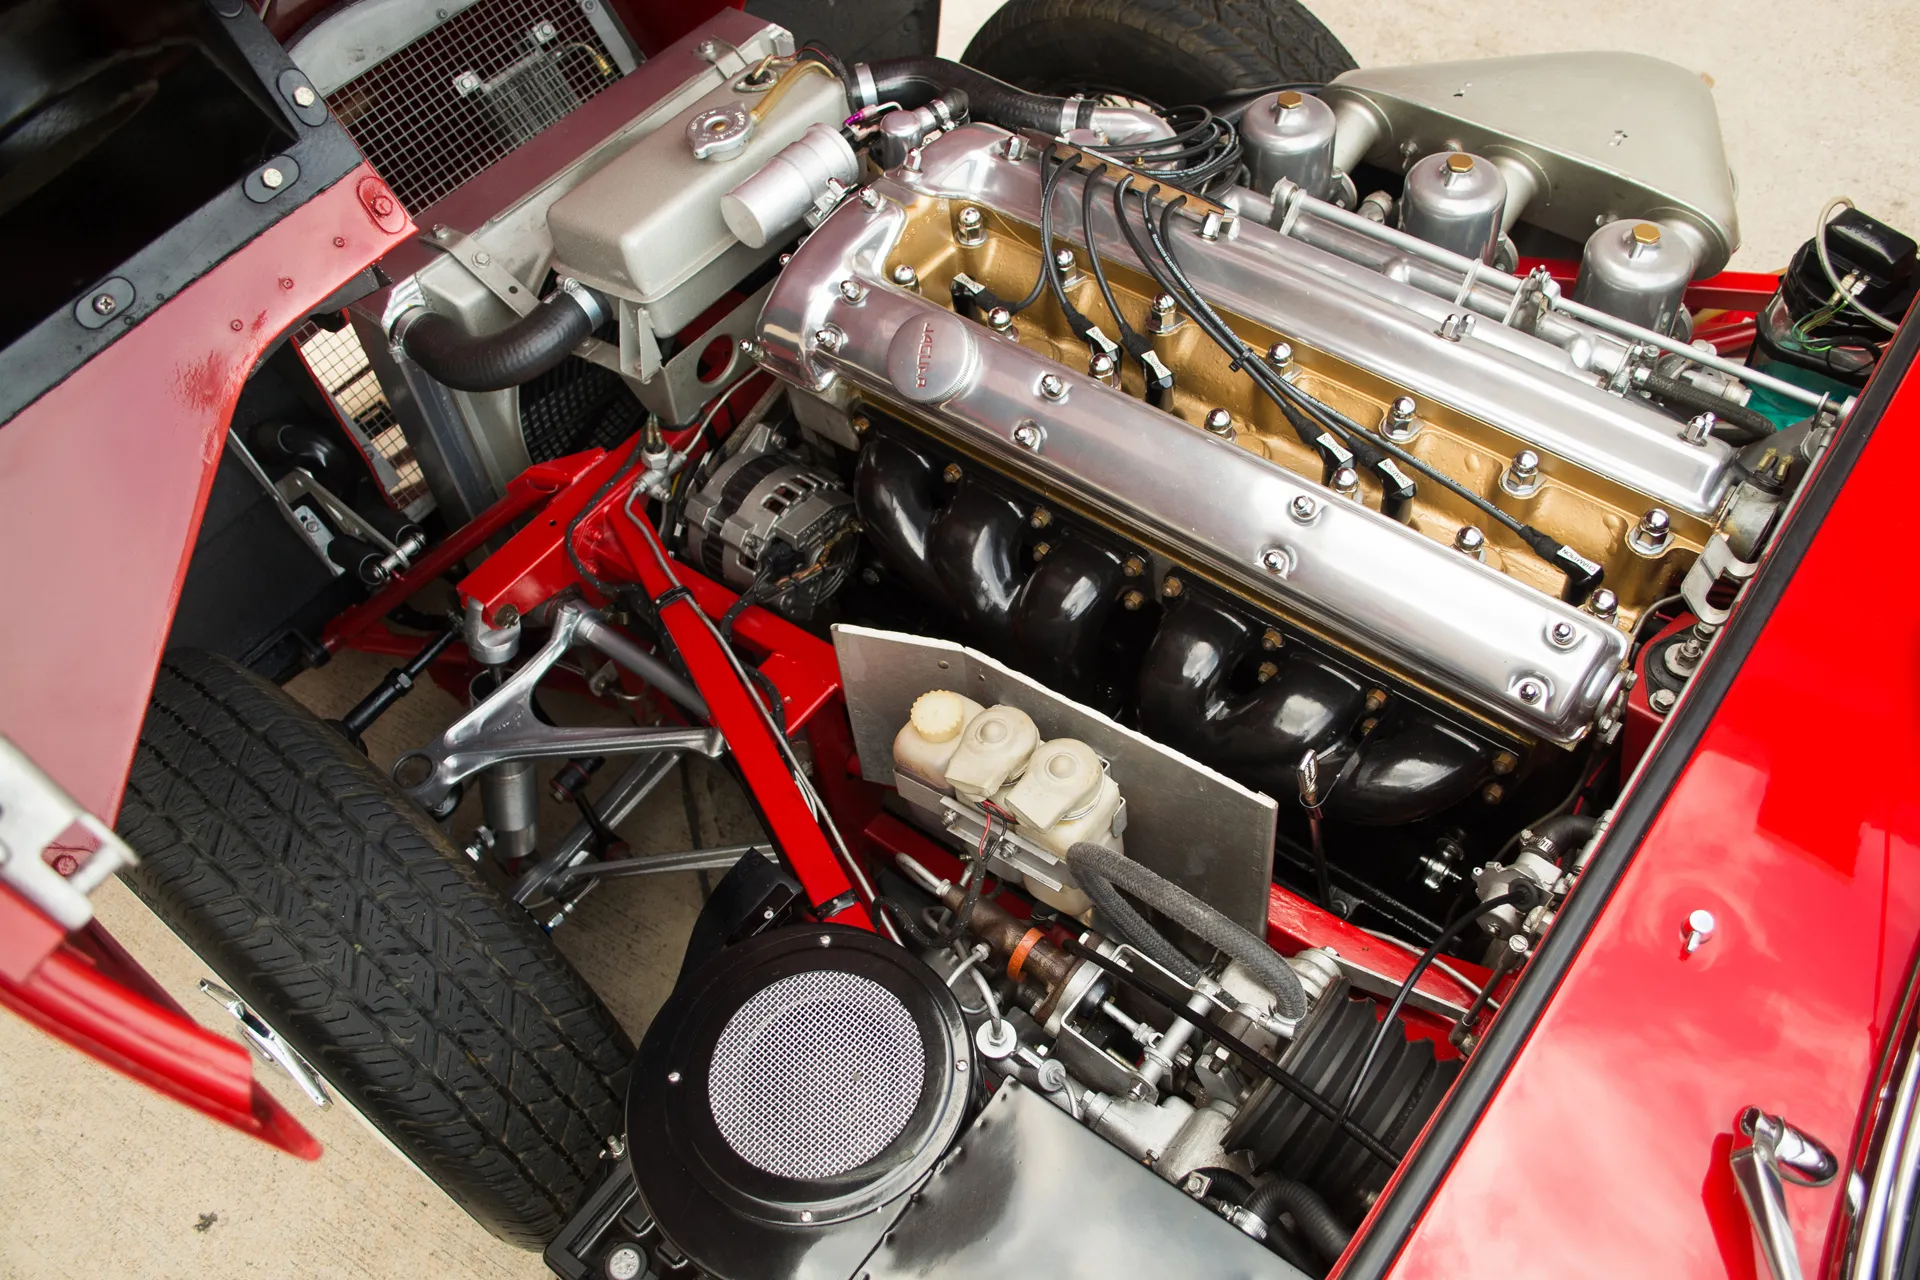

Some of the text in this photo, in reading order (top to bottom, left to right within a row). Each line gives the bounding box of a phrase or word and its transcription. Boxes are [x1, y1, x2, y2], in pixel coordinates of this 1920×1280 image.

[915, 322, 934, 389] JAGUAR
[1322, 435, 1349, 458] CHAMPION
[1383, 461, 1409, 485] CHAMPION
[1562, 549, 1597, 572] CHAMPION
